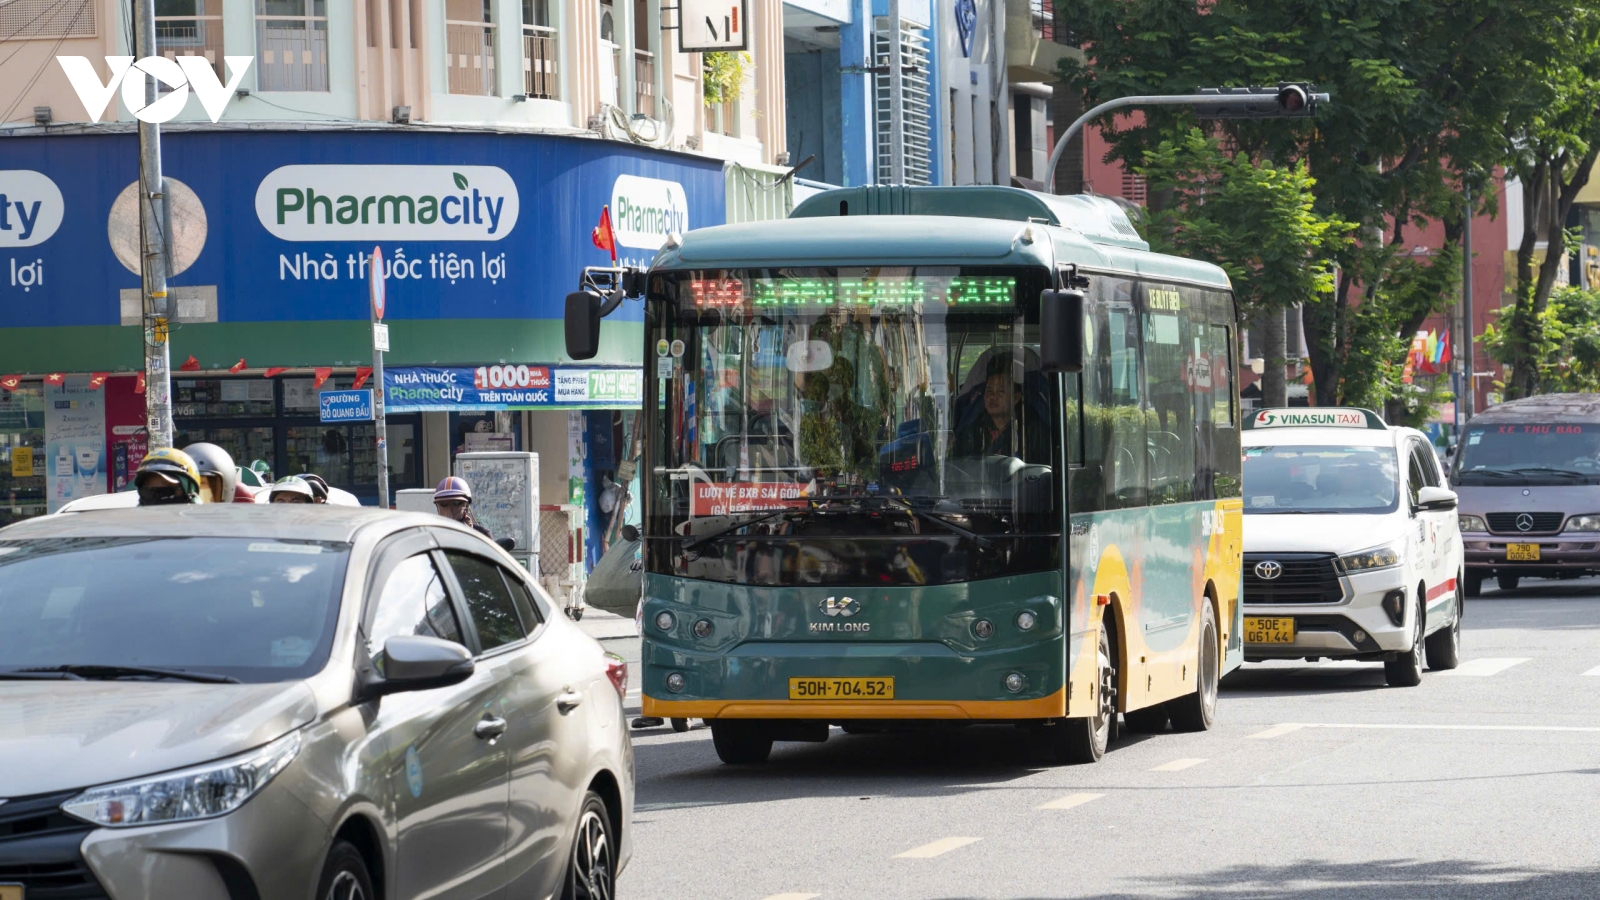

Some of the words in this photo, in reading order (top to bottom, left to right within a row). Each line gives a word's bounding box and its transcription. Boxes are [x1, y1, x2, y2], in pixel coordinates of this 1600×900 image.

[276, 187, 505, 235] Pharmacity
[618, 195, 683, 235] Pharmacity
[280, 252, 338, 280] Nhà
[429, 252, 475, 285] tiện
[482, 251, 506, 285] lợi
[10, 258, 43, 292] lợi
[394, 371, 420, 384] NHÀ
[421, 370, 457, 383] THUỐC
[476, 364, 530, 388] 1000
[530, 369, 542, 377] NHÀ
[530, 378, 549, 386] THUỐC
[330, 394, 360, 404] ĐƯỜNG
[389, 385, 464, 402] Pharmacity
[479, 390, 500, 403] TRÊN
[502, 390, 524, 402] TOÀN
[525, 389, 548, 402] QUỐC
[332, 408, 354, 418] QUANG
[1280, 414, 1335, 424] VINASUN
[1337, 414, 1360, 424] TAXI
[1497, 425, 1516, 434] XE
[1523, 424, 1552, 434] THƯ
[1555, 424, 1583, 434] BÁO
[739, 487, 759, 498] BXB
[810, 622, 834, 632] KIM
[837, 622, 871, 632] LONG
[1257, 619, 1280, 630] 50E
[1248, 631, 1289, 642] 061.44
[797, 681, 886, 696] 50H-704.52
